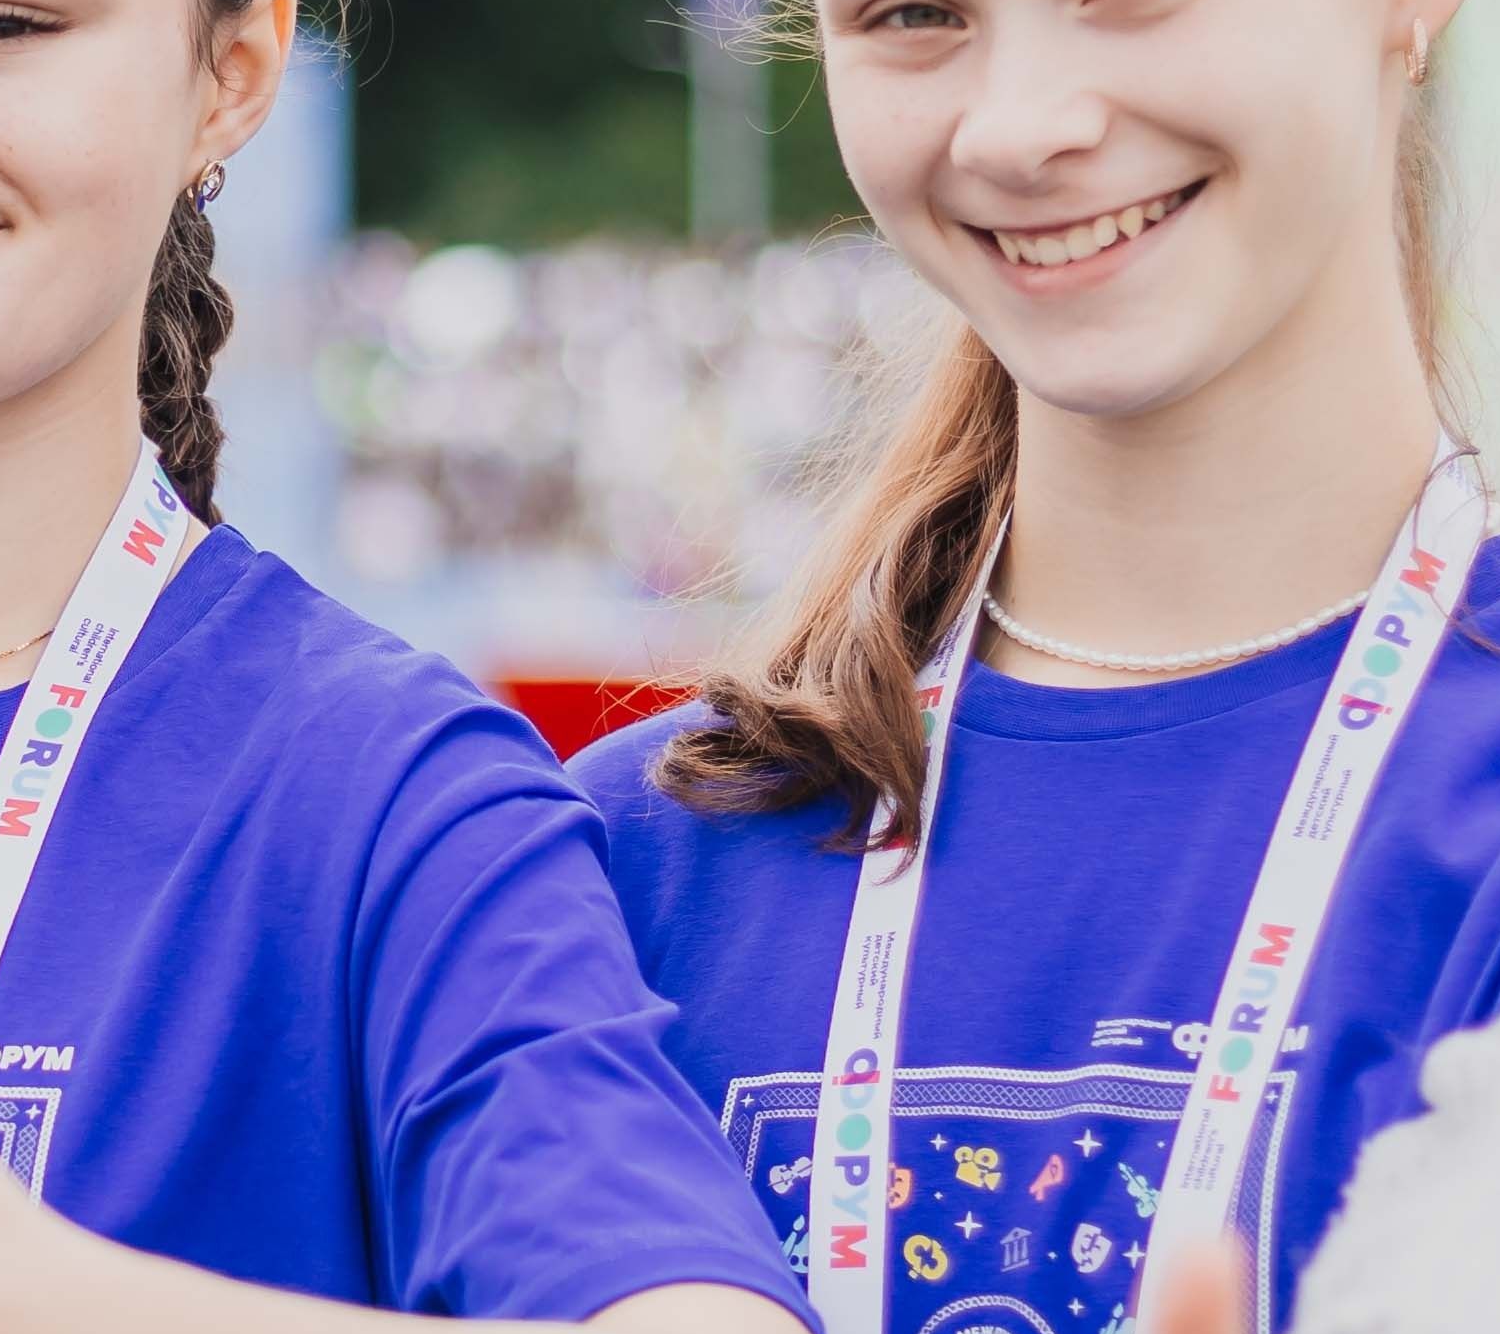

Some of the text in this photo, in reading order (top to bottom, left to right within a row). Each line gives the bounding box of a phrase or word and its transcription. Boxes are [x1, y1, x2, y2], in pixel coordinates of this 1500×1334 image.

[69, 617, 91, 653] cultural
[76, 623, 104, 666] children's
[83, 627, 119, 684] International
[1337, 548, 1447, 731] ФОРУМ
[1294, 733, 1339, 838] Международный
[1308, 787, 1332, 839] детский
[1320, 768, 1352, 841] культурный
[856, 936, 871, 1010] культурный
[870, 935, 882, 986] детский
[872, 931, 895, 1040] Международный
[1206, 922, 1296, 1103] FORUM
[830, 1048, 880, 1268] ФОРУМ
